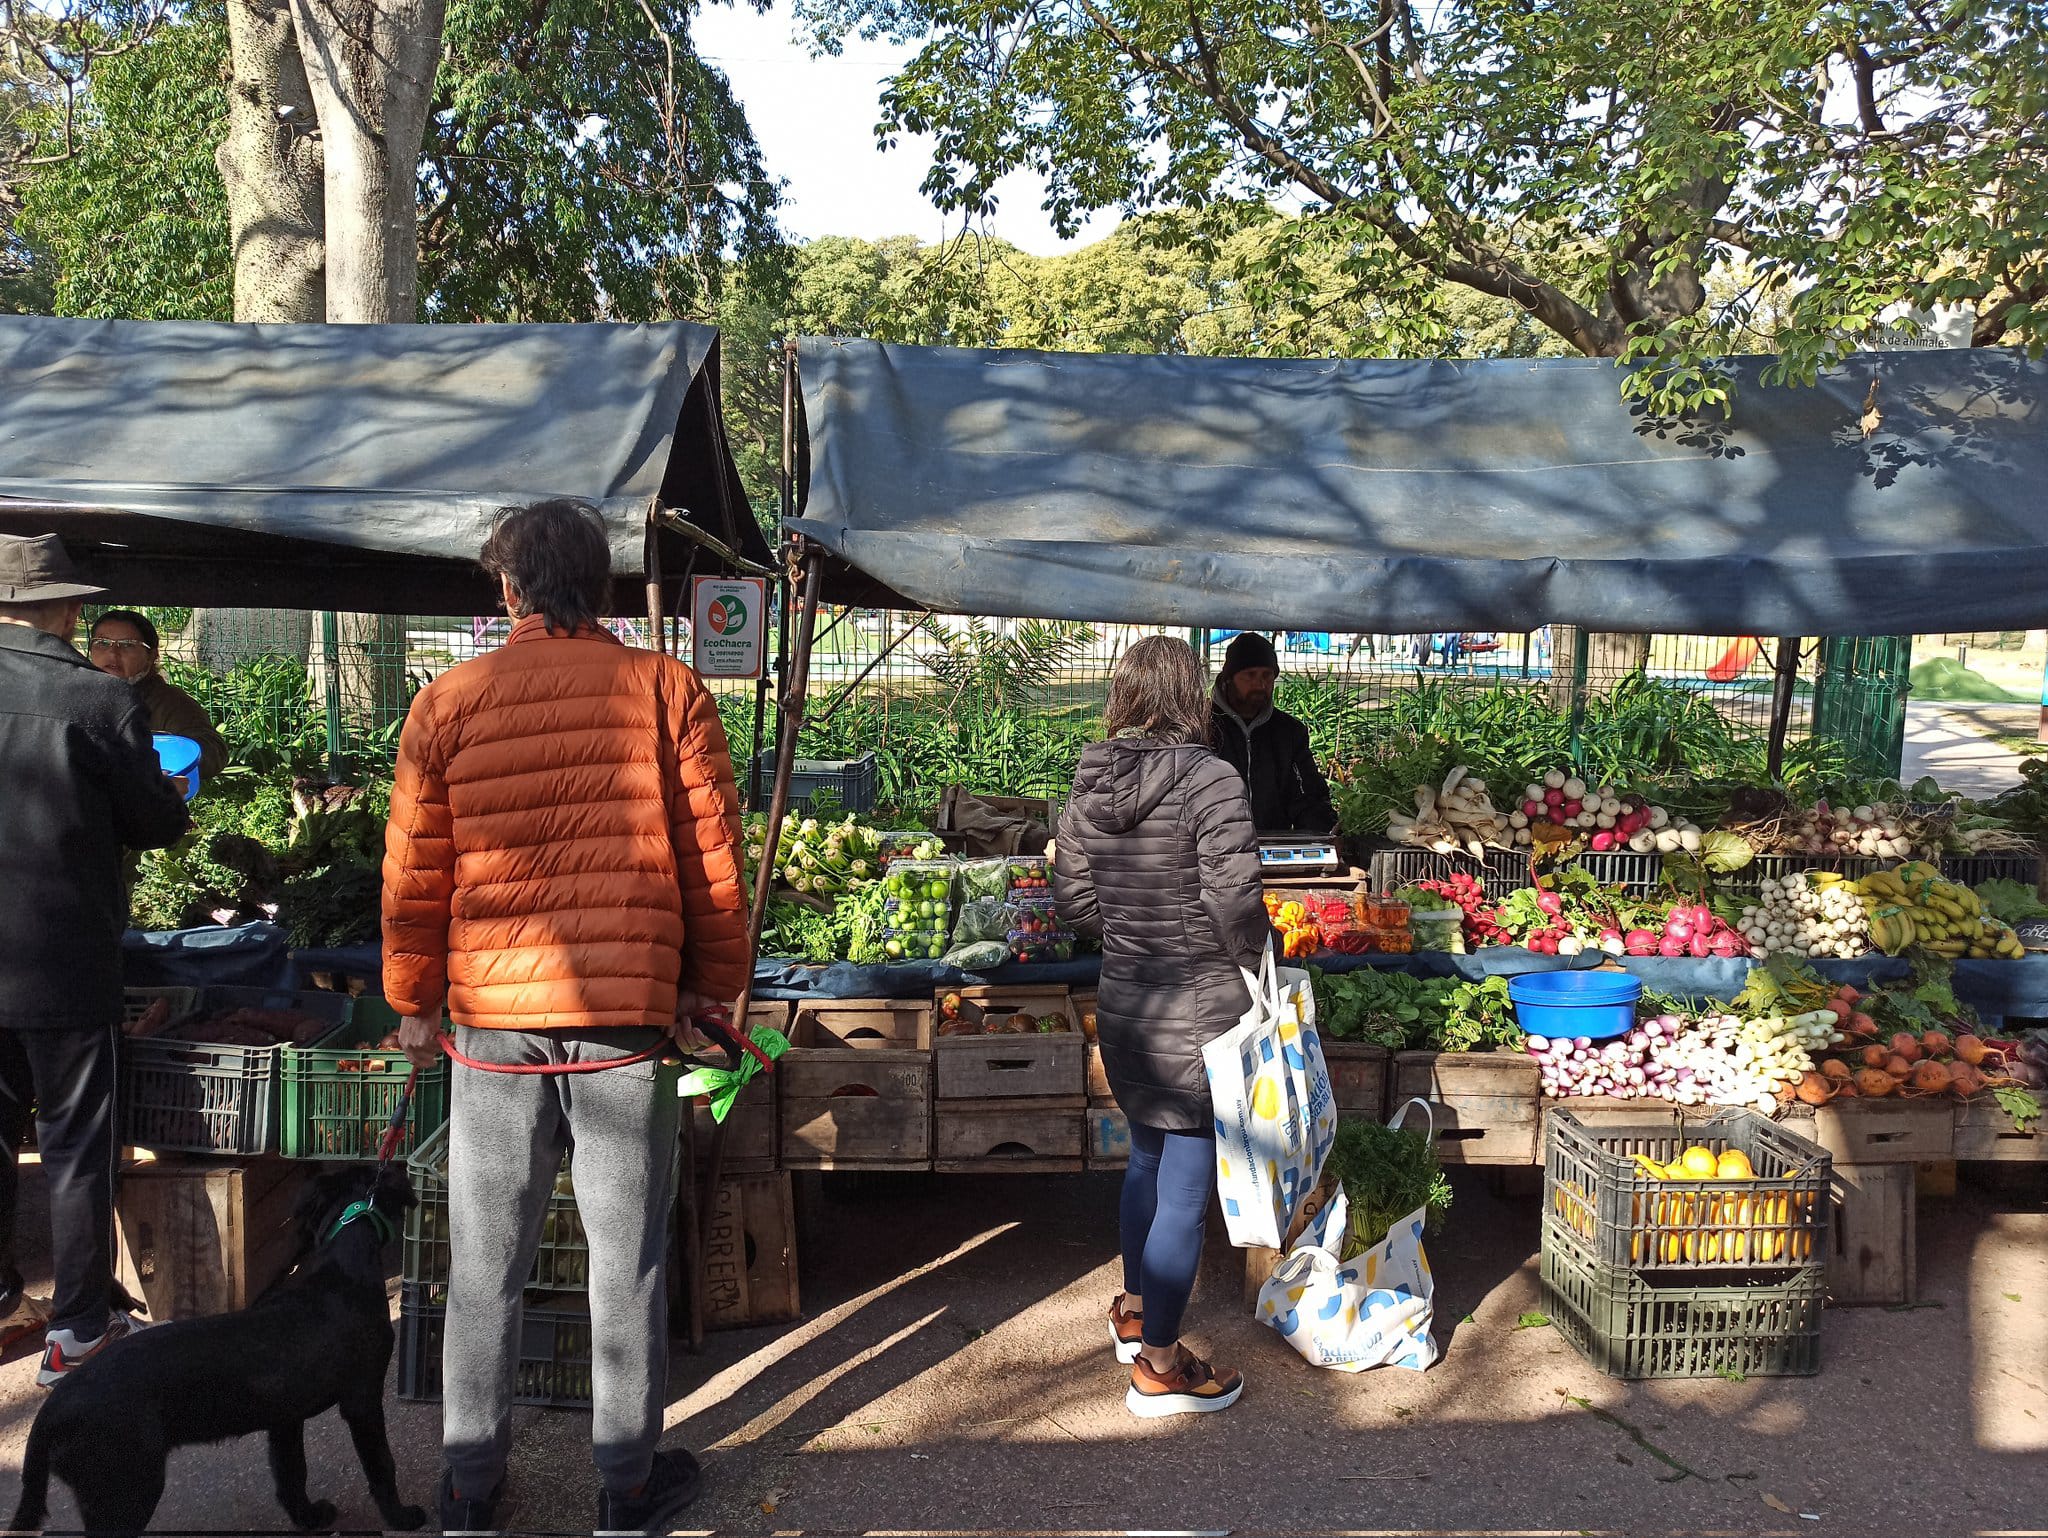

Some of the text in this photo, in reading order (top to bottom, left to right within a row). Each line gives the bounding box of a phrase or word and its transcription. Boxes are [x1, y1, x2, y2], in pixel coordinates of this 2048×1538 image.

[1848, 333, 1950, 348] ingeo de animales
[703, 638, 752, 649] EcoChacra
[2019, 923, 2048, 938] ORE
